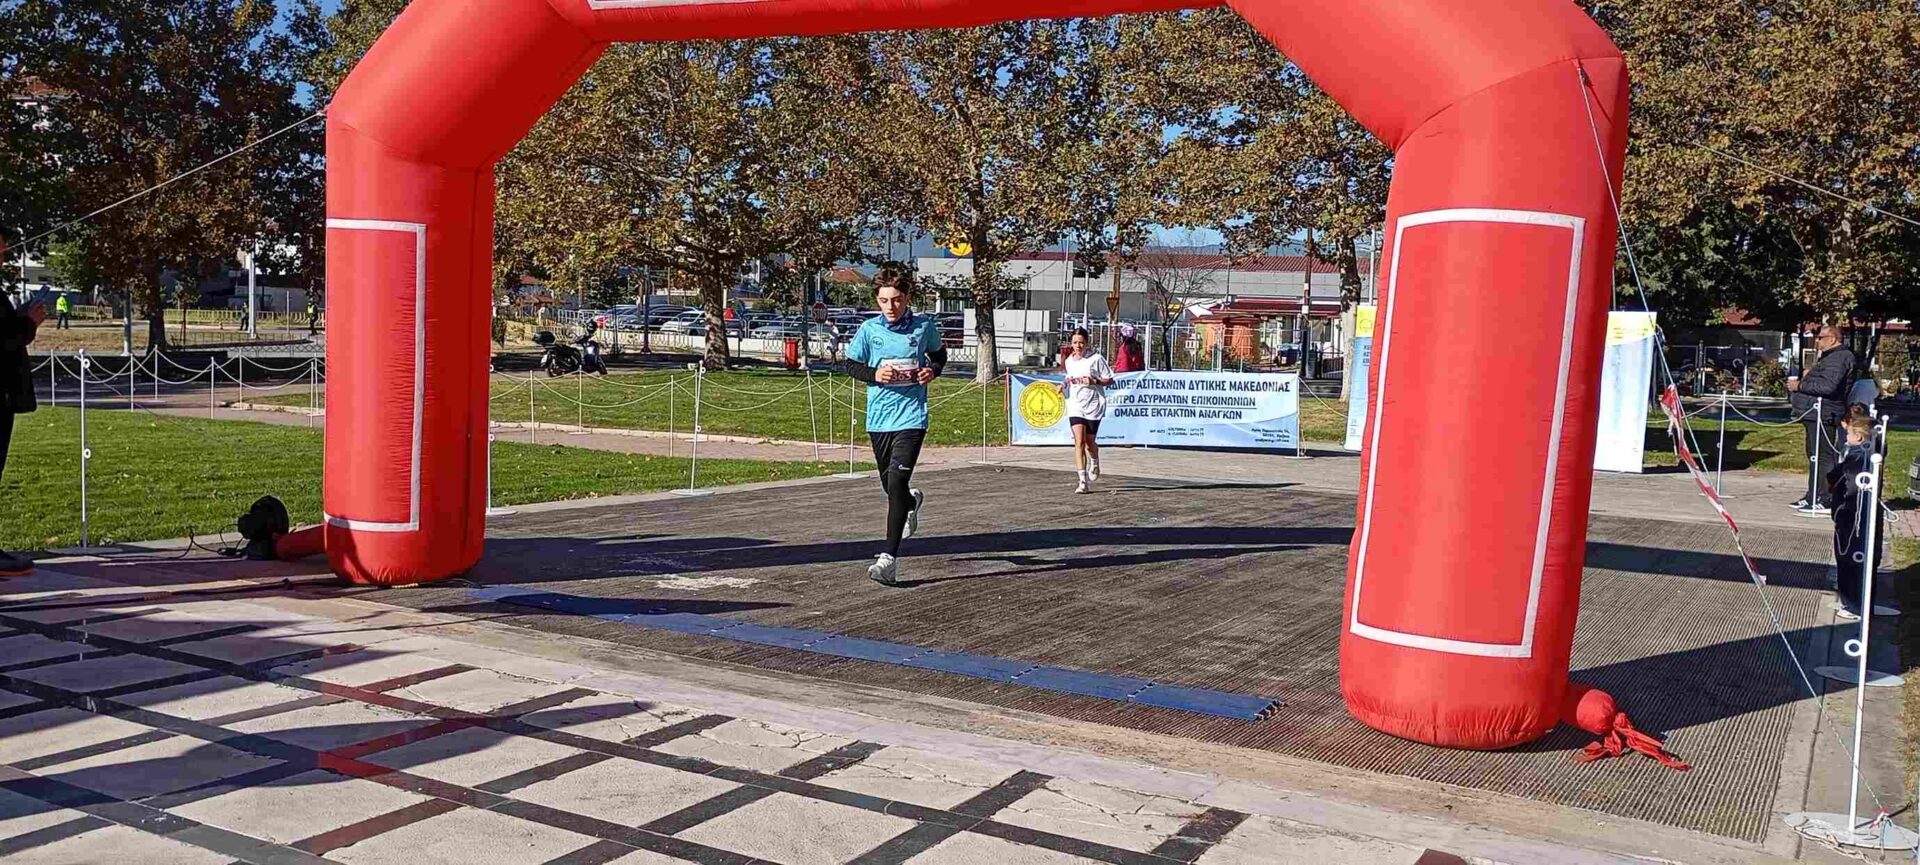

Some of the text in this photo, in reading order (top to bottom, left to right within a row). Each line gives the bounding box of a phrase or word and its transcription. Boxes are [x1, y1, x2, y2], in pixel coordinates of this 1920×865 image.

[1105, 378, 1290, 392] ΑΔΙΟΕΡΑΣΙΤΕΧΝΩΝ ΔΥΤΙΚΗΣ ΜΑΚΕΔΟΝΙΑΣ
[1107, 394, 1256, 407] ΕΝΤΡΟ ΑΣΥΡΜΑΤΩΝ ΕΠΙΚΟΙΝΩΝΙΩΝ
[1114, 408, 1242, 420] ΟΜΑΔΕΣ ΕΚΤΑΚΤΩΝ ΑΝΑΓΚΩΝ
